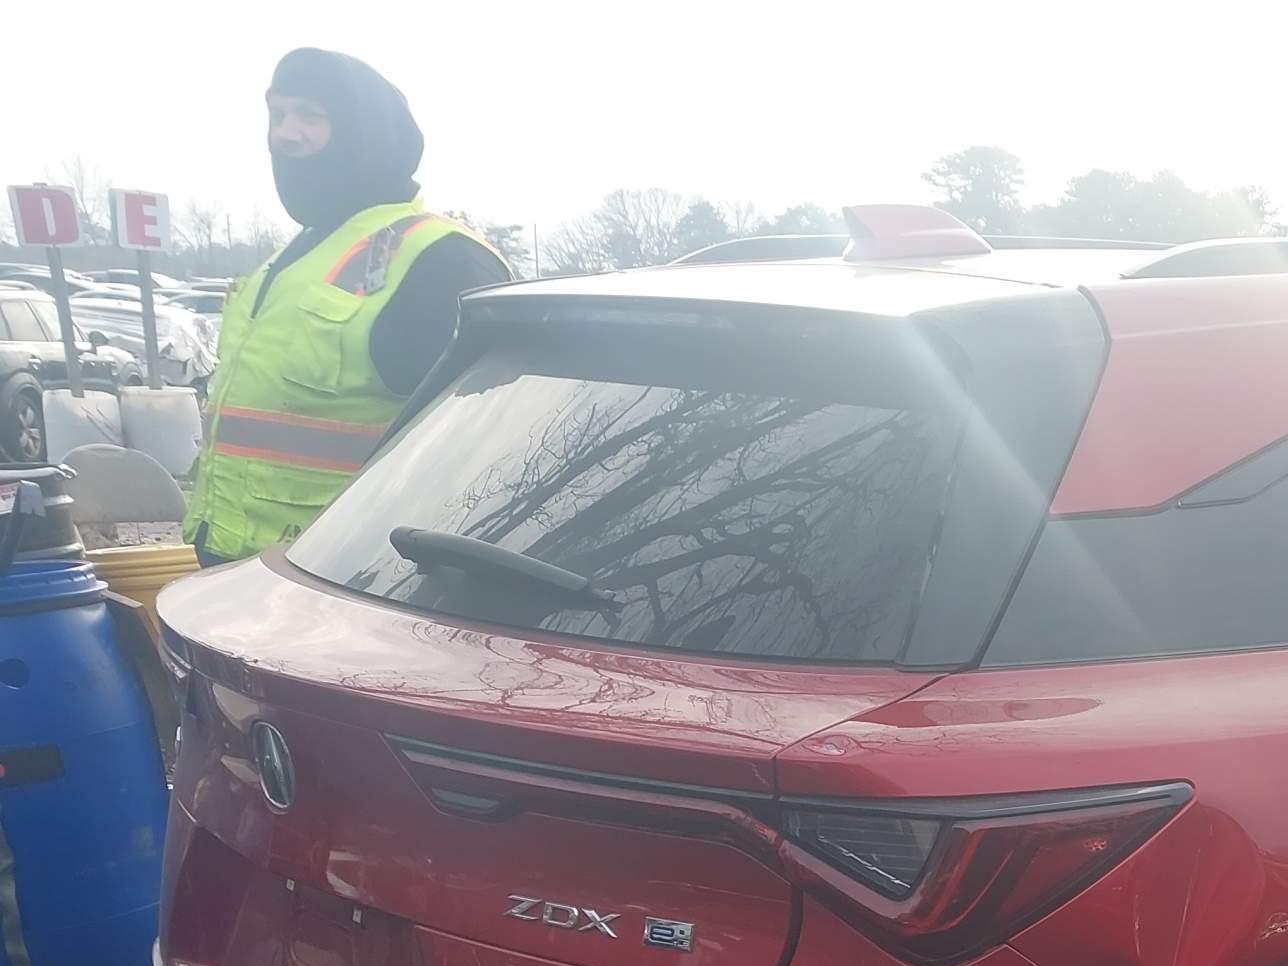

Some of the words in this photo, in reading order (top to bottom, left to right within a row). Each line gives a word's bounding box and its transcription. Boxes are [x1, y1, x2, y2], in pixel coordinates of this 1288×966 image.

[16, 187, 80, 244] D
[124, 193, 162, 247] E
[503, 894, 621, 938] ZDX
